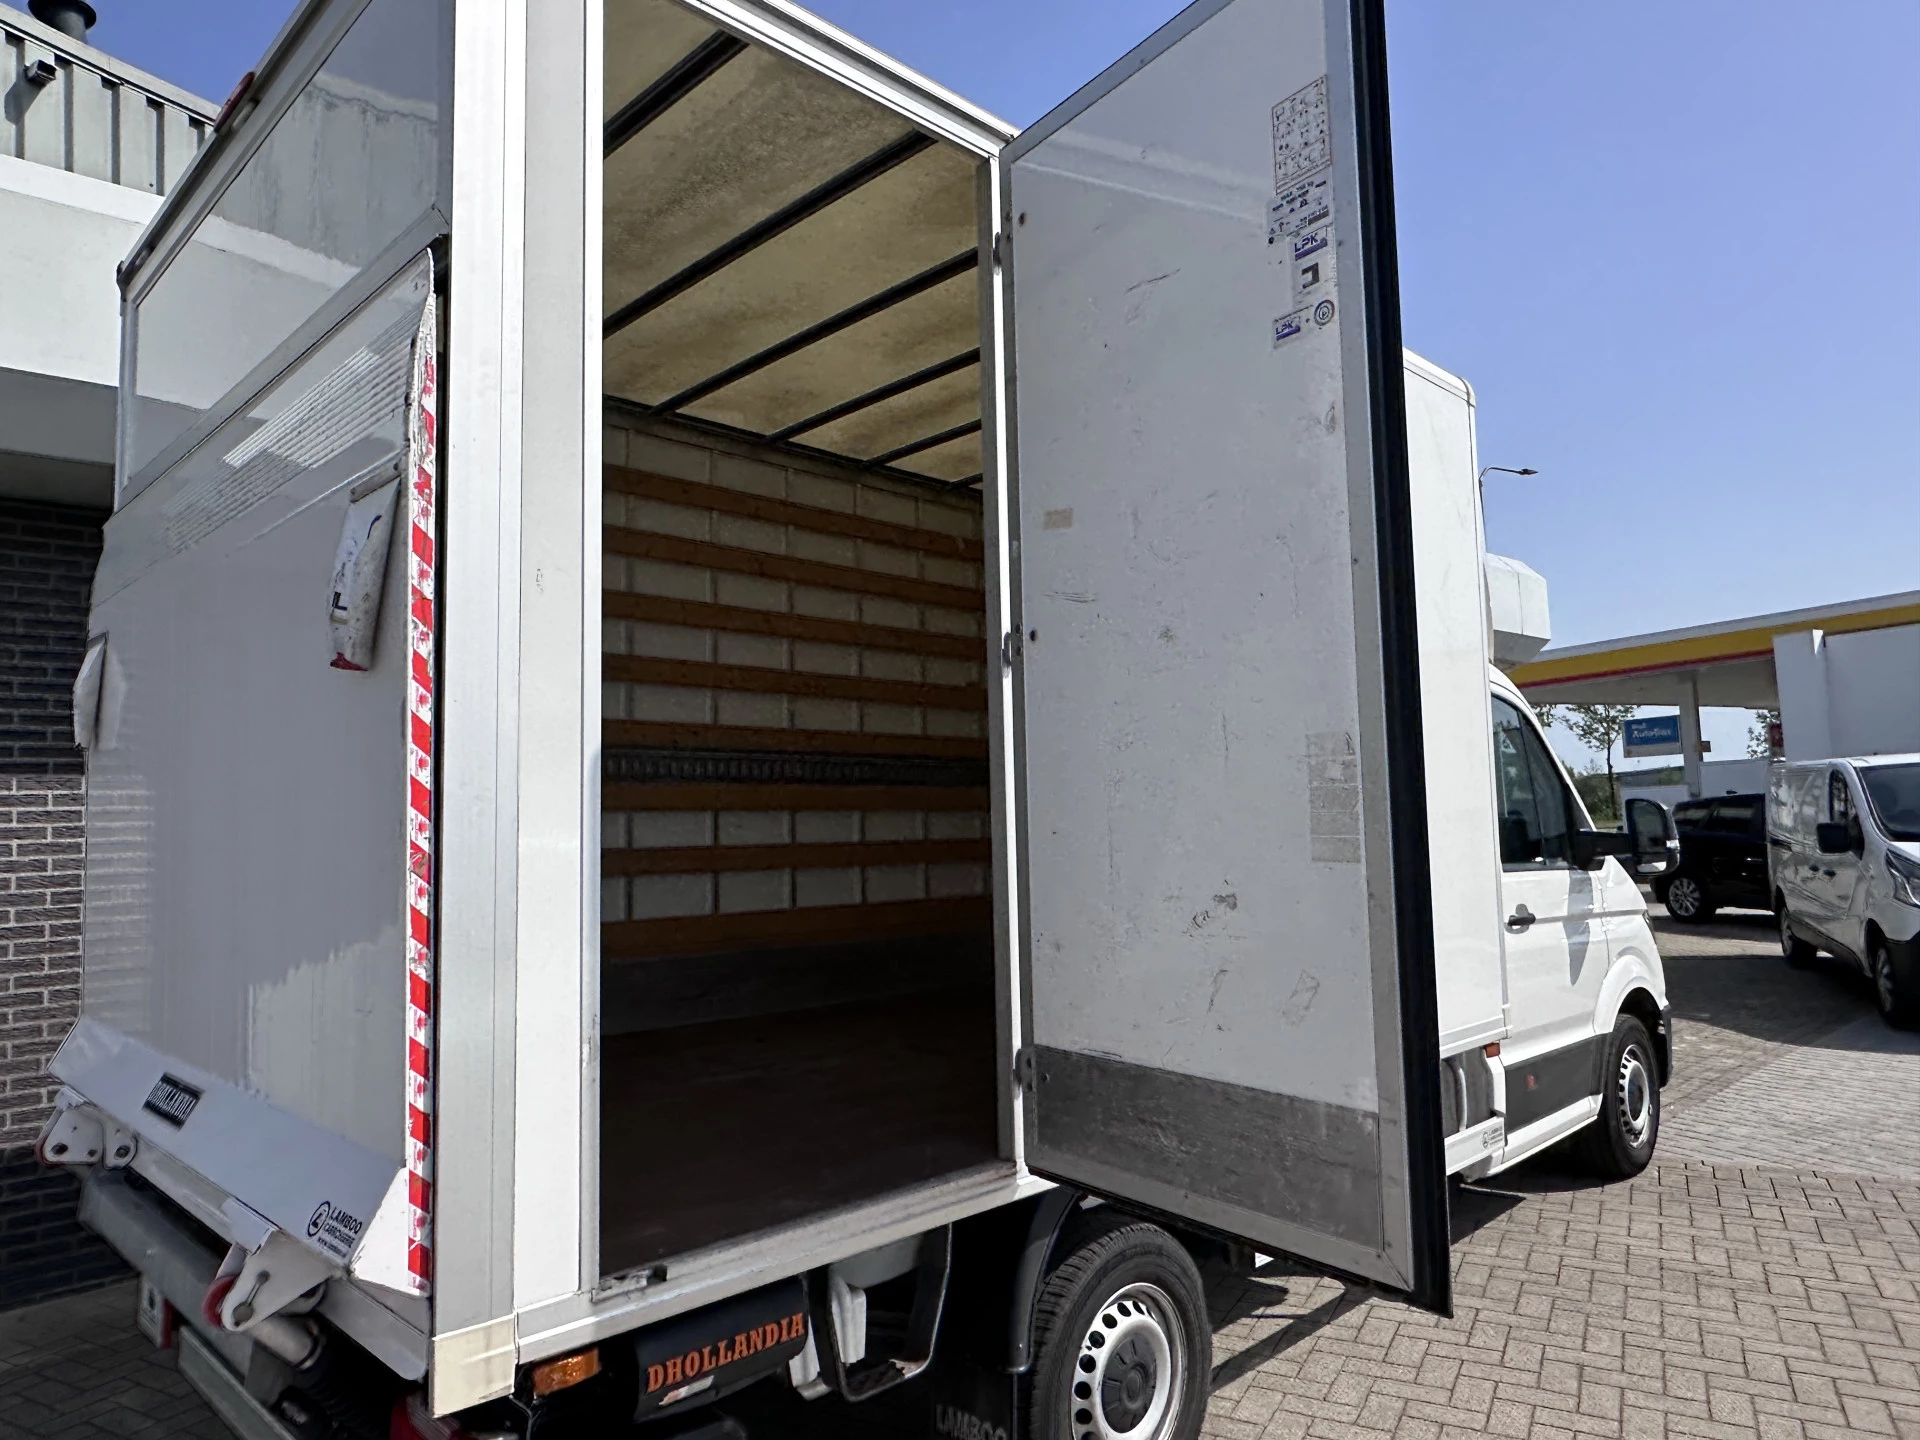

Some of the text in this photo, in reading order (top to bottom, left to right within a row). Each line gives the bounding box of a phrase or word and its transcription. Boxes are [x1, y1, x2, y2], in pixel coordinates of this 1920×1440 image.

[1294, 232, 1318, 253] LPK
[330, 1206, 363, 1235] LAMBOO
[646, 1312, 805, 1393] DHOLLANDIA
